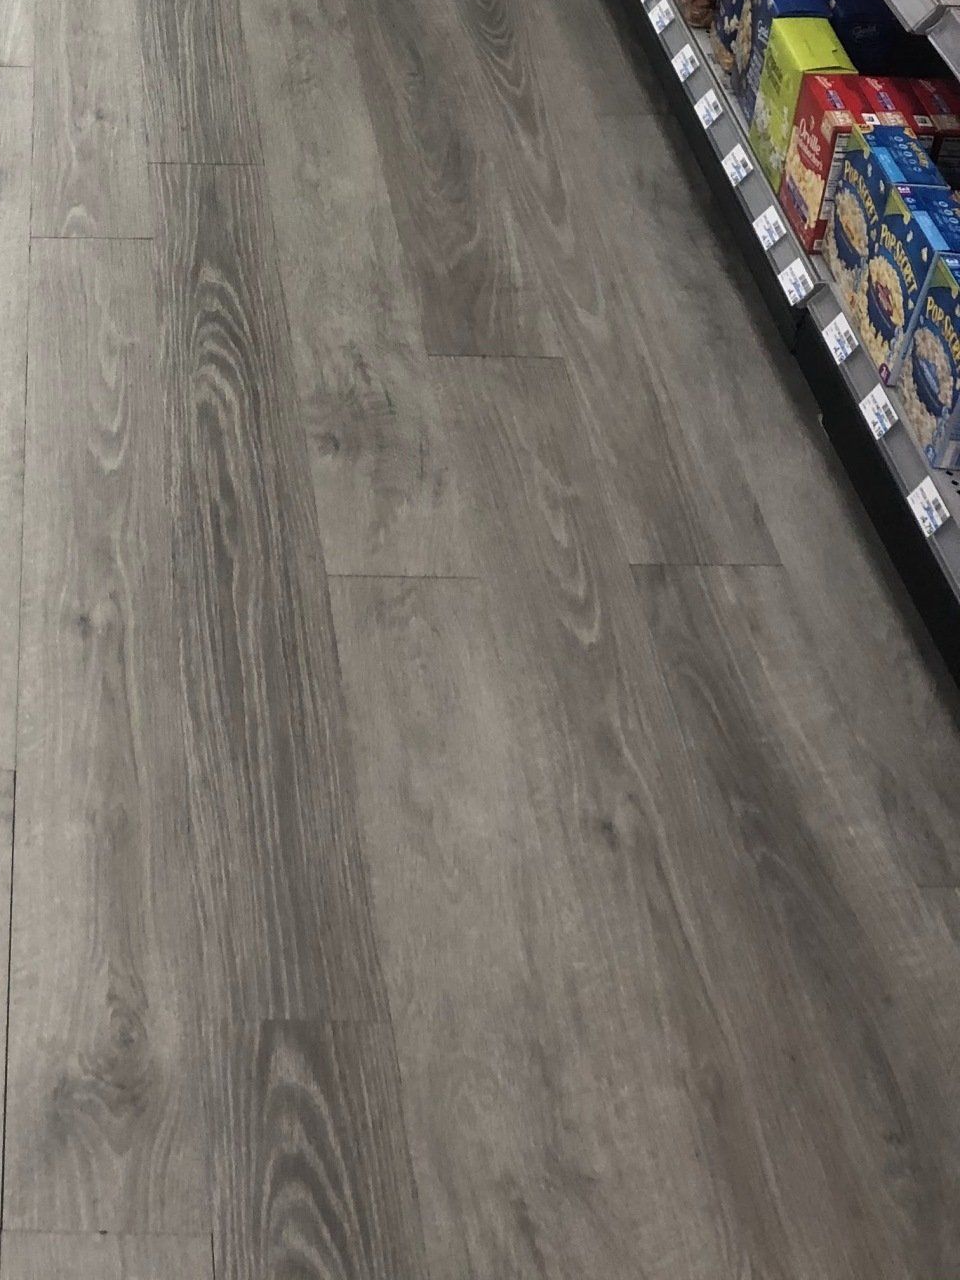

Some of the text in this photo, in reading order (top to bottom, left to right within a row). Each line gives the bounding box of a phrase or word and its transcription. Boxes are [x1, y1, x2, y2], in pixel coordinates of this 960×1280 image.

[895, 241, 918, 293] SECRET
[926, 297, 946, 324] POP
[871, 420, 884, 439] 4.19
[919, 515, 934, 537] 4.79
